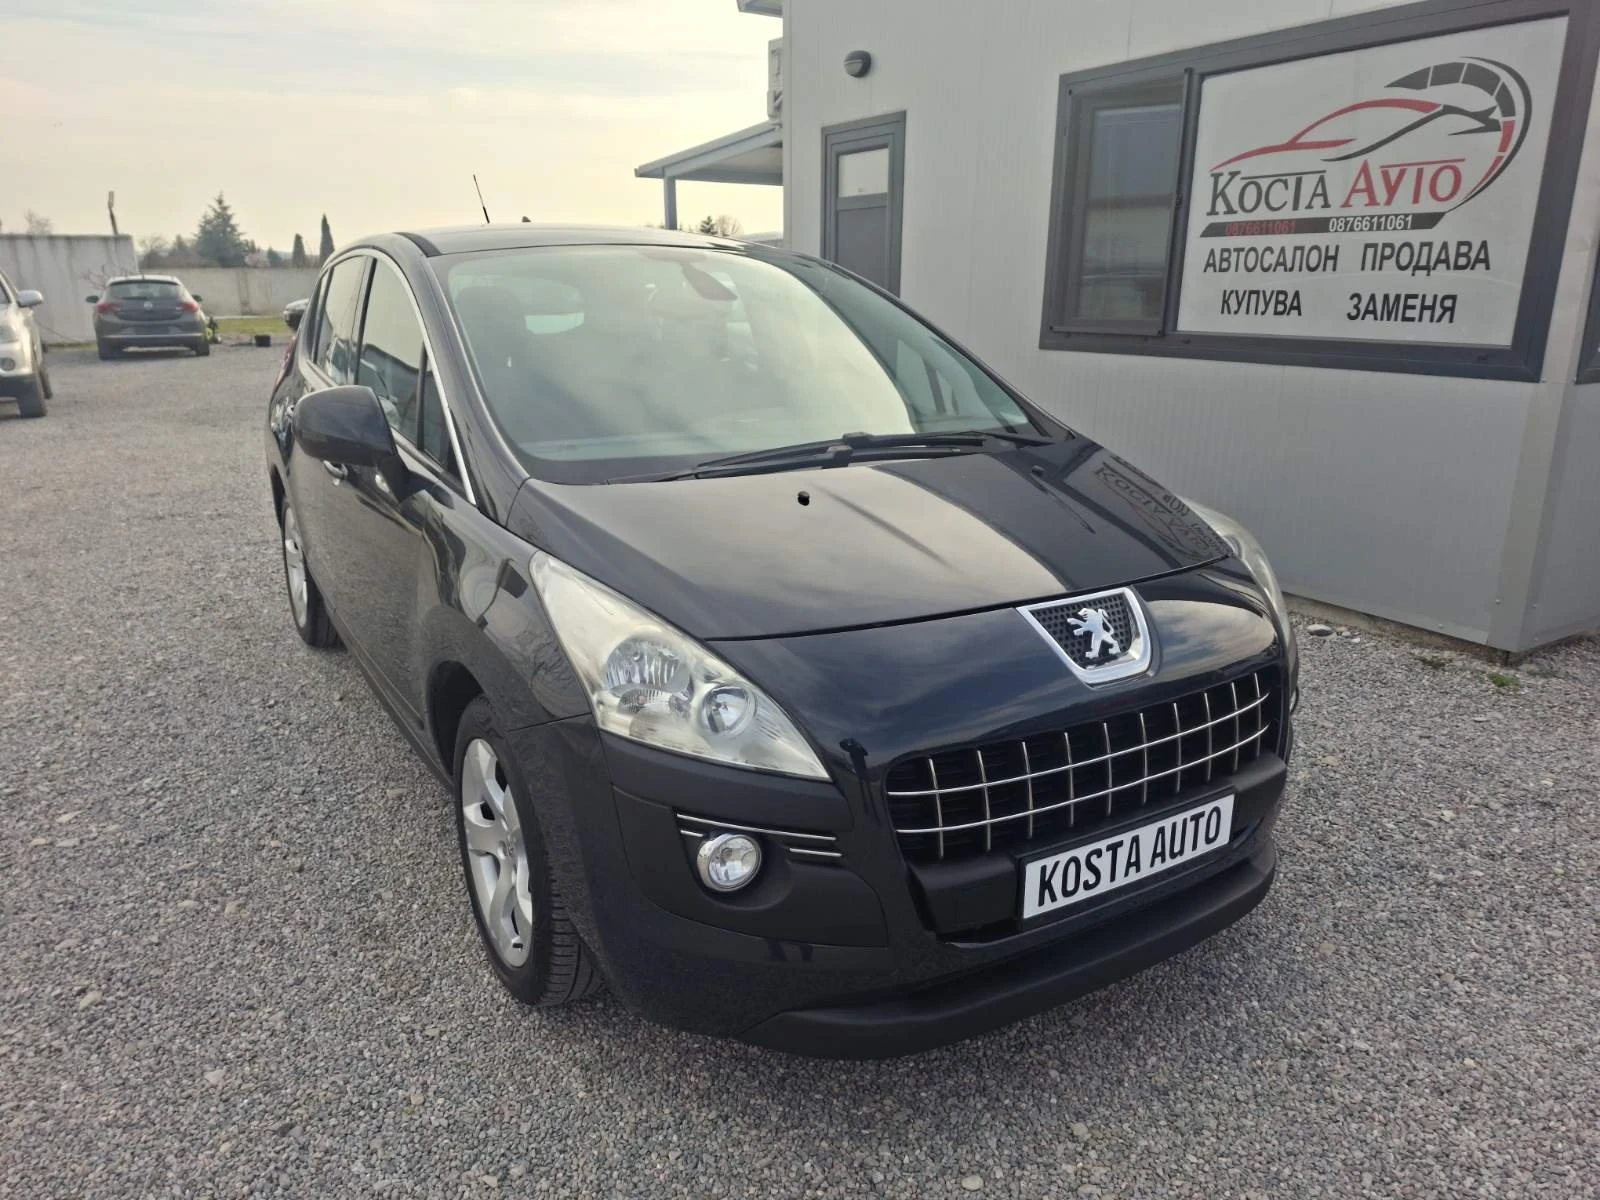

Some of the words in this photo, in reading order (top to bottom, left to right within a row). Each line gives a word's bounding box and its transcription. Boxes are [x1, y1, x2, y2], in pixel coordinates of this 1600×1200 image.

[1328, 214, 1413, 232] 0876611061
[1203, 244, 1339, 273] АВТОСАЛОН
[1360, 239, 1490, 277] ПРОДАВА
[1220, 288, 1302, 317] КУПУВА
[1346, 292, 1458, 324] ЗАМЕНЯ
[1037, 833, 1141, 908] KOSTA
[1149, 805, 1222, 868] AUTO
